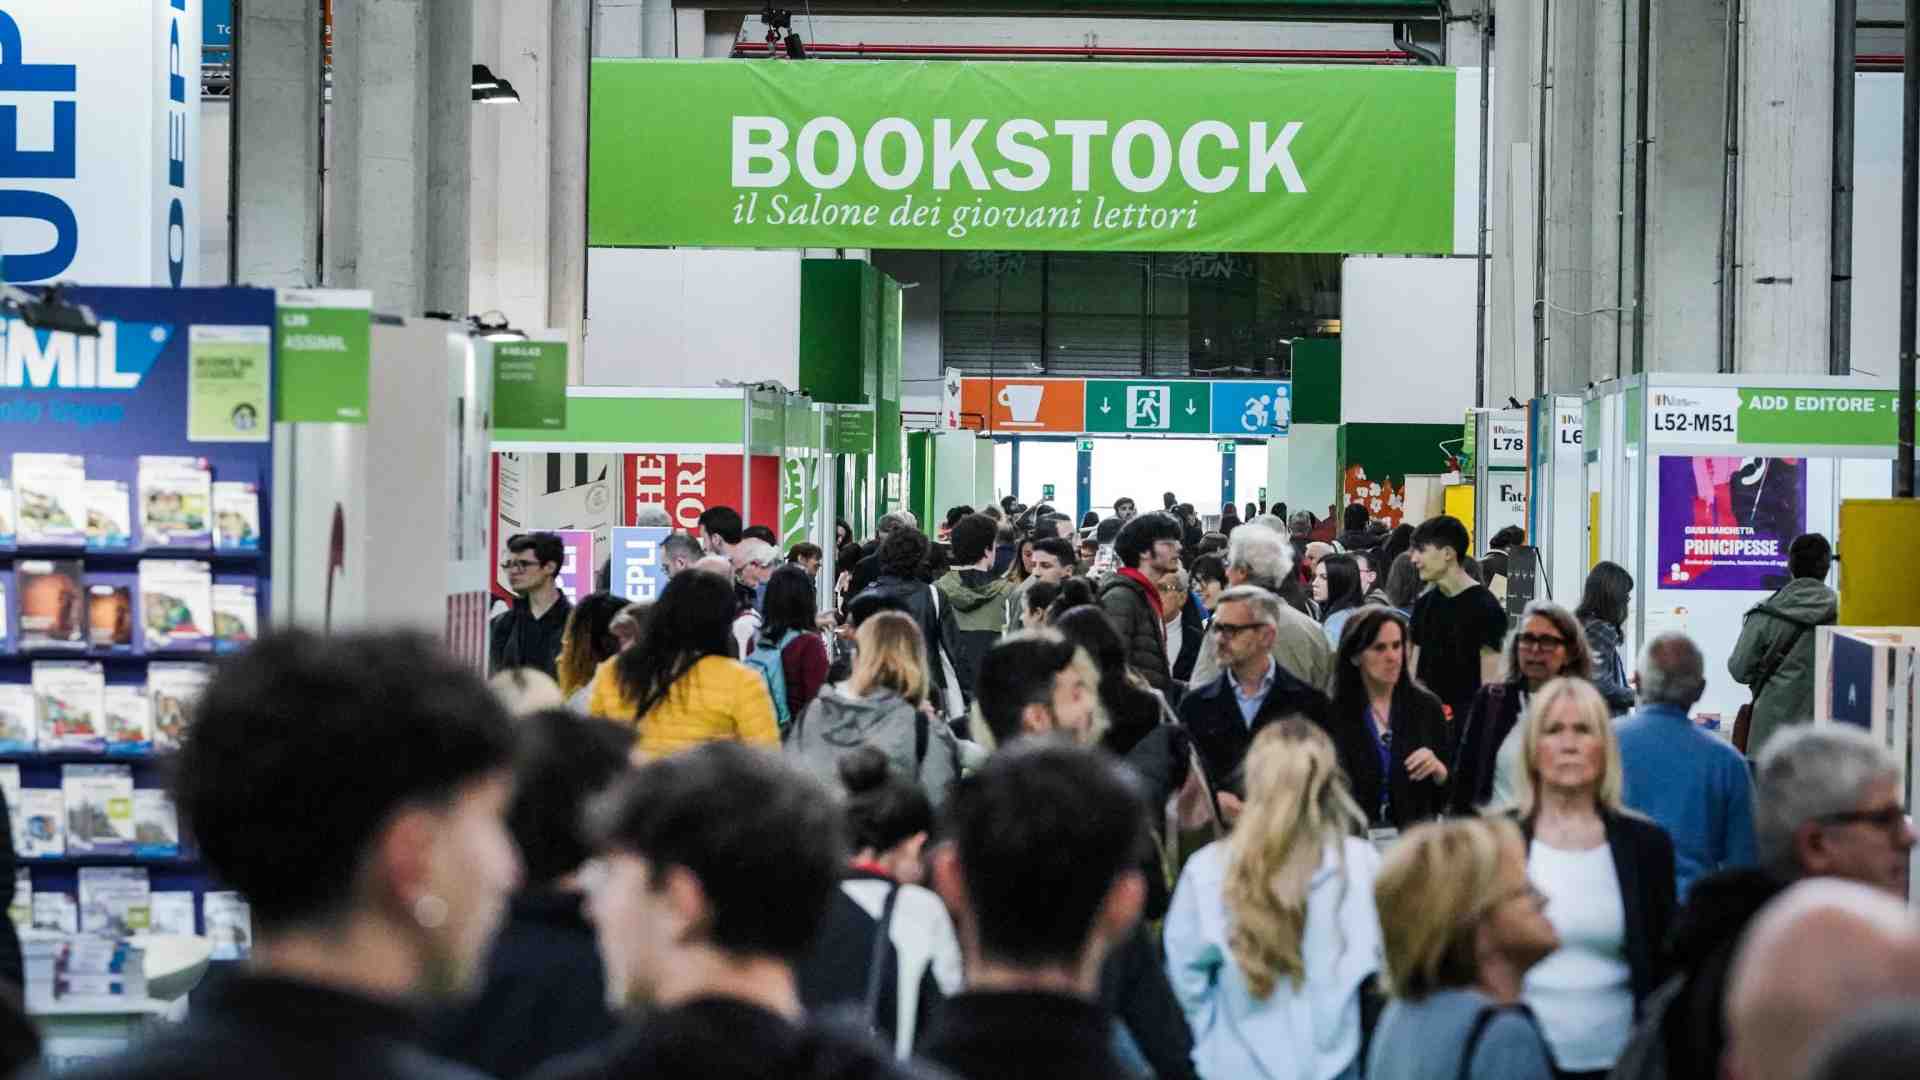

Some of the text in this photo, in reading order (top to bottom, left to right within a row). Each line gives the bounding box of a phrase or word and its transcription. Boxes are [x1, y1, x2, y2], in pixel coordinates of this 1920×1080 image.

[731, 115, 1307, 194] BOOKSTOCK
[733, 193, 1199, 238] il Salone dei giovani lettori
[1748, 396, 1789, 412] ADD
[1795, 396, 1875, 412] EDITORE
[1654, 412, 1735, 432] L52-M51
[1493, 438, 1524, 451] L78
[1684, 539, 1779, 556] PRINCIPESSE
